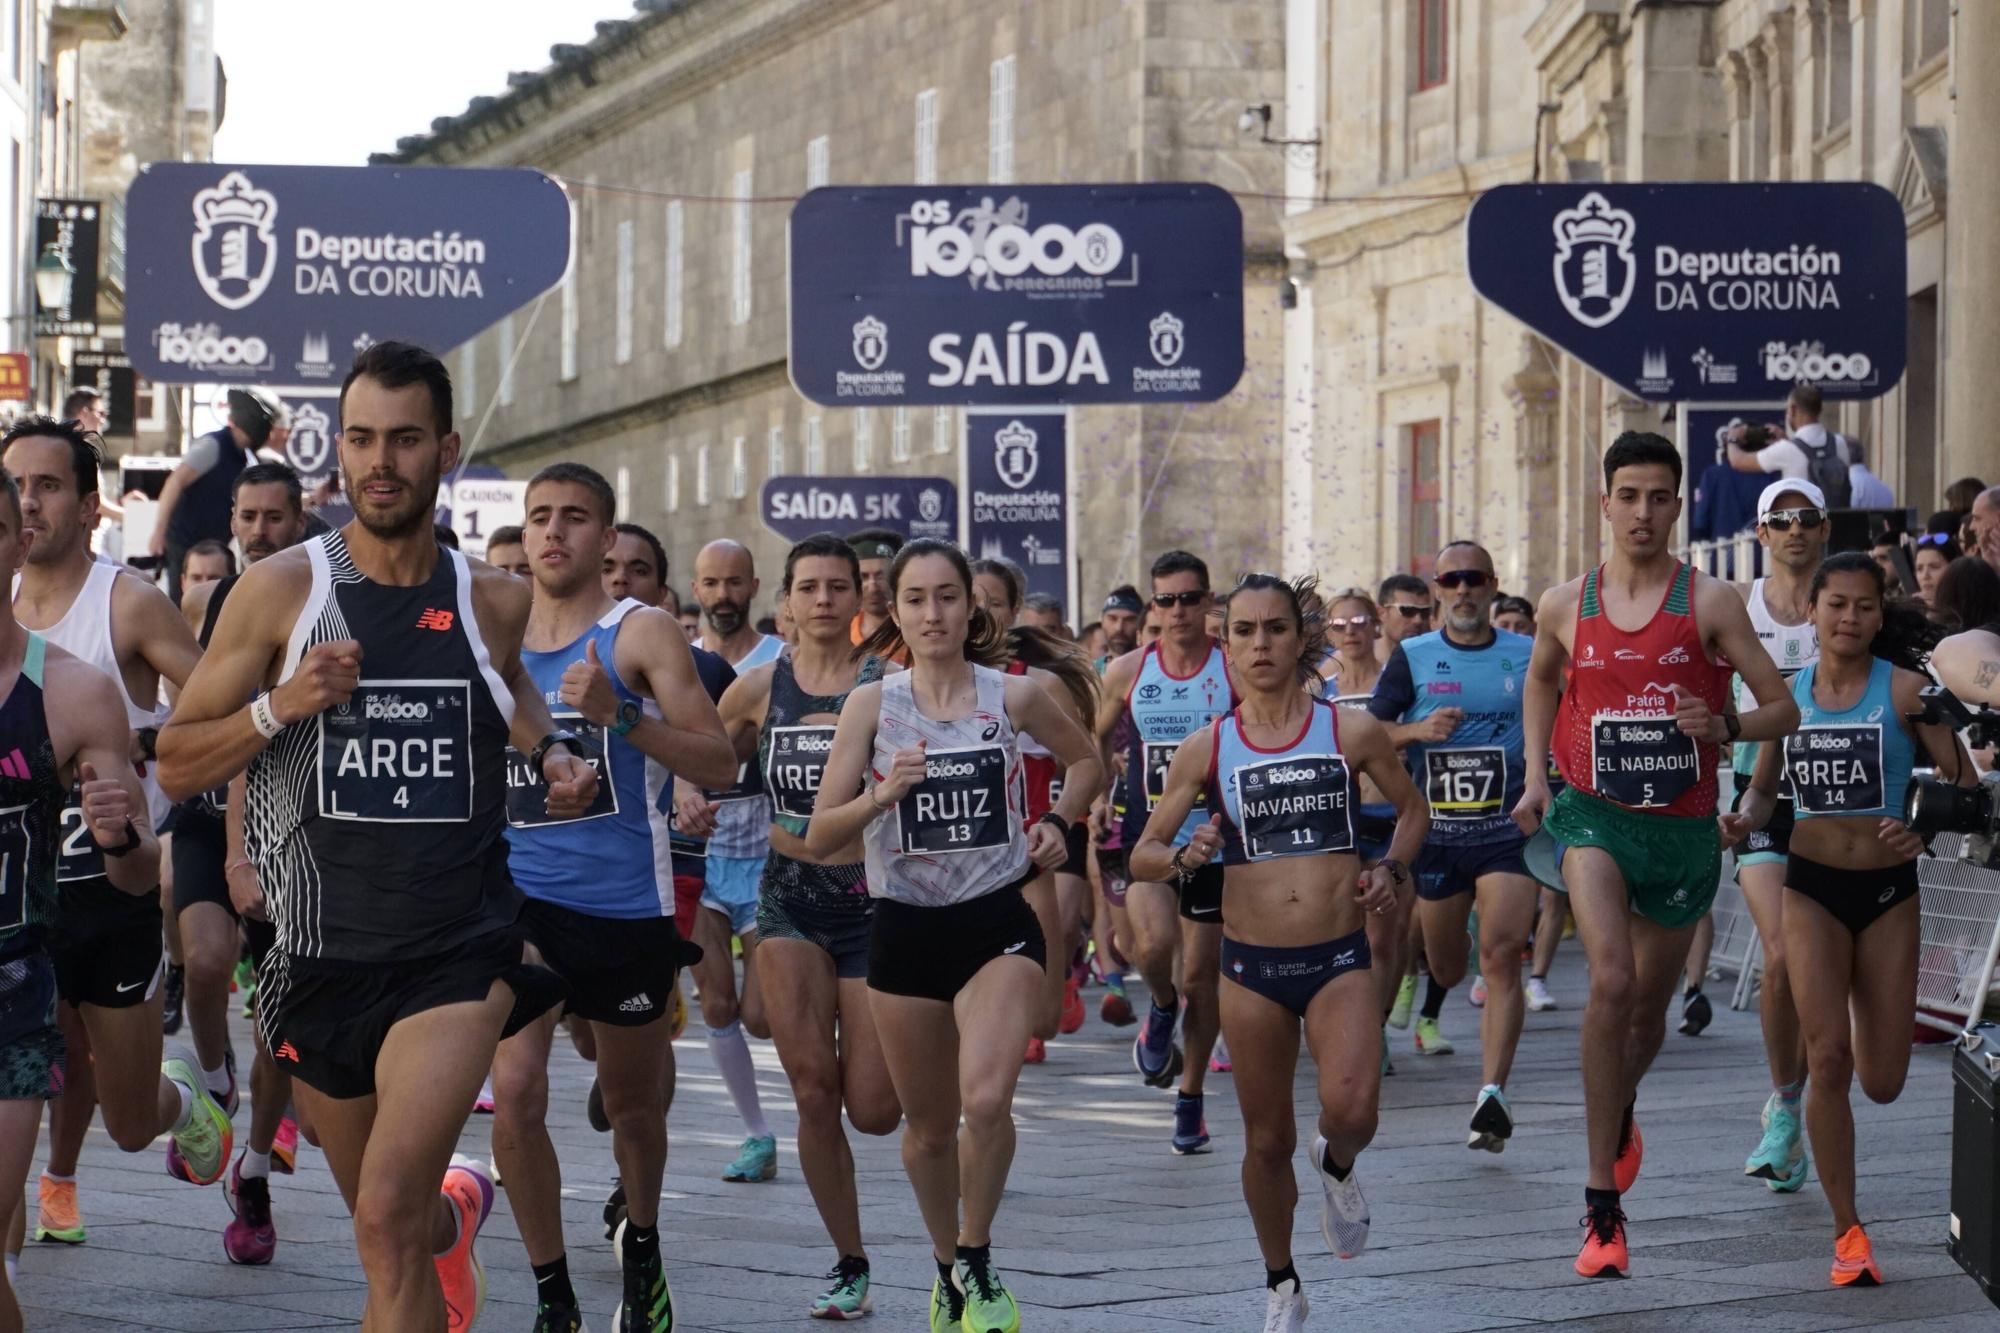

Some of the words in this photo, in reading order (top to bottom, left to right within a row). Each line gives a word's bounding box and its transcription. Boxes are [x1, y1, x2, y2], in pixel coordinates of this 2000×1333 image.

[911, 200, 951, 225] OS
[297, 228, 484, 268] Deputación
[911, 222, 1123, 277] 10.000
[1655, 245, 1841, 285] Deputación
[296, 265, 338, 295] DA
[348, 261, 483, 298] CORUÑA
[1655, 282, 1698, 311] DA
[1708, 276, 1839, 311] CORUÑA
[928, 321, 1109, 386] SAÍDA
[771, 487, 857, 520] SAÍDA
[864, 493, 902, 521] 5K
[974, 491, 1060, 510] Deputación
[464, 510, 483, 539] 1
[974, 508, 994, 522] DA
[999, 505, 1060, 522] CORUÑA
[1627, 694, 1665, 707] Patria
[1144, 716, 1191, 725] CONCELLO
[1165, 726, 1186, 734] VIGO
[337, 738, 454, 778] ARCE
[1597, 757, 1616, 772] EL
[1620, 754, 1694, 771] NABAOUI
[777, 765, 827, 791] IRE
[1795, 760, 1868, 786] BREA
[393, 786, 409, 809] 4
[1440, 770, 1494, 802] 167
[1643, 783, 1654, 798] 5
[1825, 790, 1845, 805] 14
[916, 788, 991, 822] RUIZ
[1243, 792, 1344, 818] NAVARRETE
[948, 824, 971, 842] 13
[1291, 827, 1314, 845] 11
[1277, 963, 1306, 971] XUNTA
[619, 1000, 653, 1012] adidas
